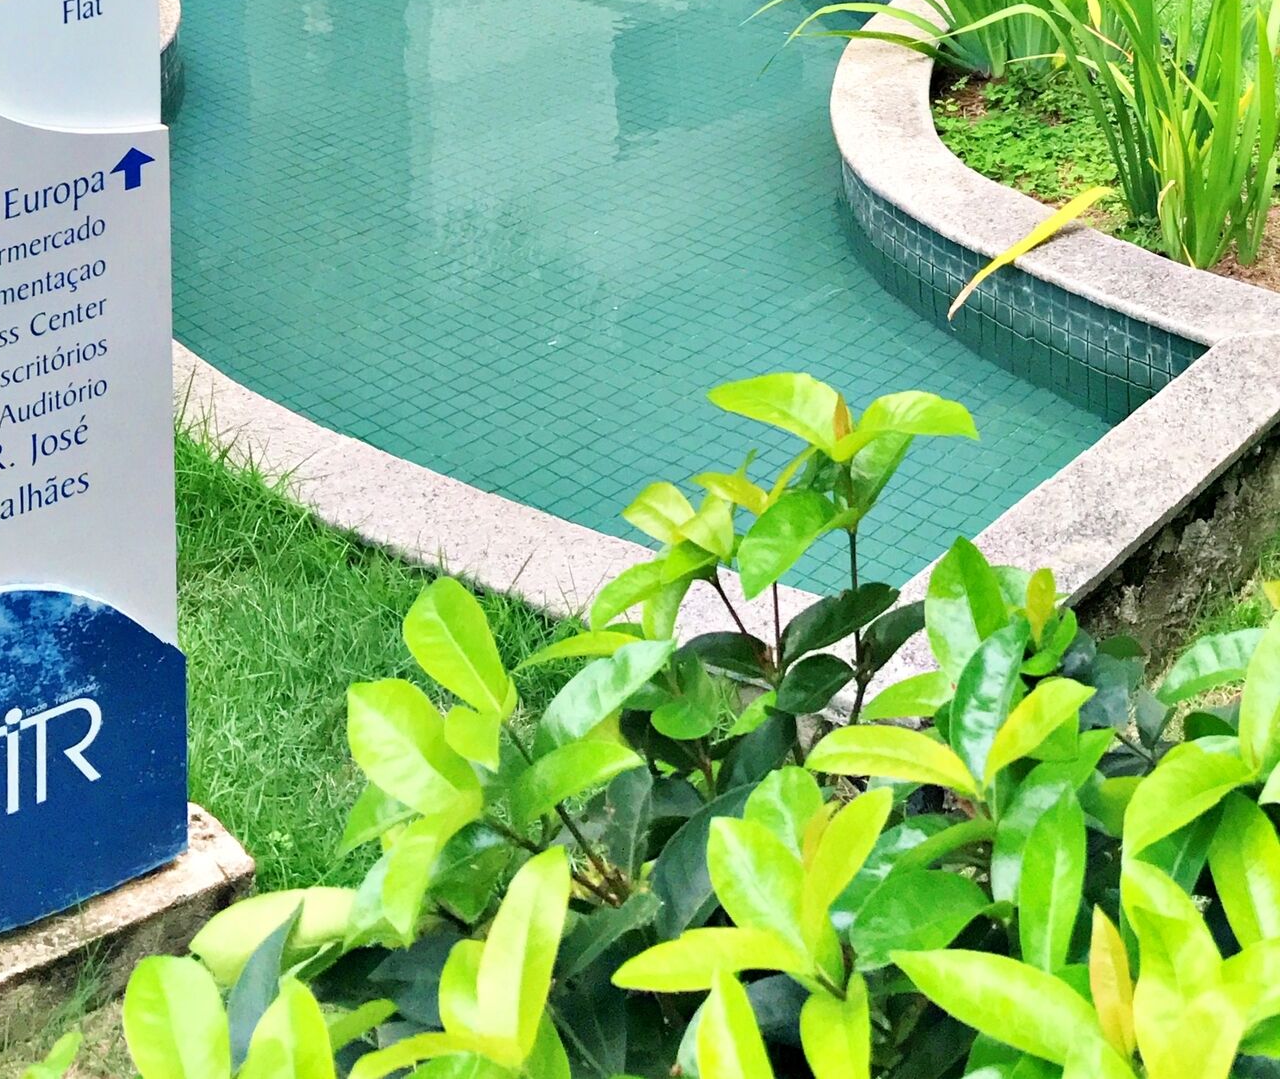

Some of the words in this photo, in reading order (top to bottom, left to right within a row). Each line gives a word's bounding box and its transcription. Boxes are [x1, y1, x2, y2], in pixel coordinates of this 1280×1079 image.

[4, 170, 105, 220] Europa
[29, 298, 107, 337] Center
[31, 414, 89, 466] José
